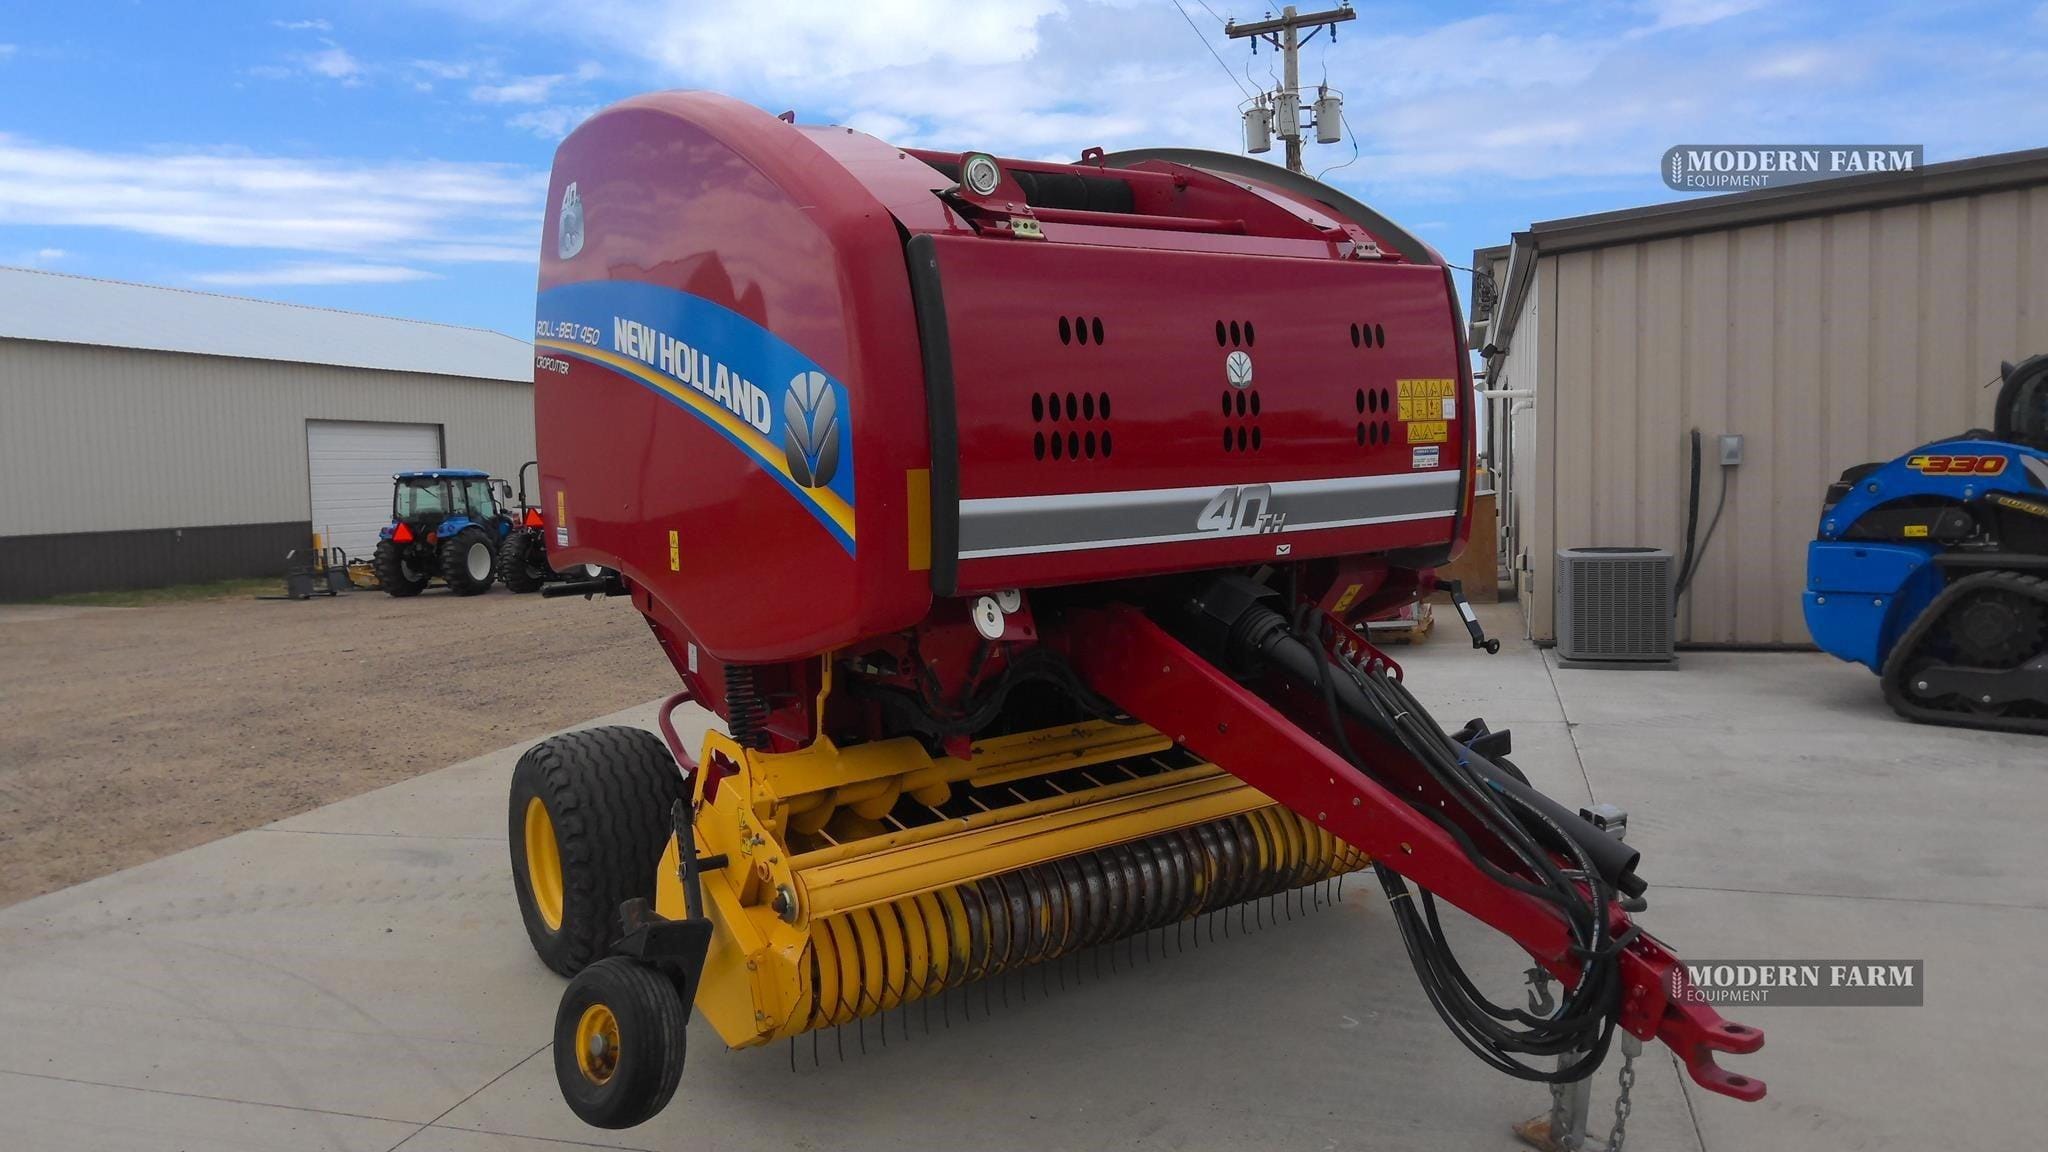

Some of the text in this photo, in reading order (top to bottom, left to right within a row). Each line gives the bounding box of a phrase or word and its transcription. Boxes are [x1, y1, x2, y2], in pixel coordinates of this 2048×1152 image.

[536, 320, 600, 345] ROLL-BELT 450
[614, 316, 772, 434] NEW HOLLAND
[1907, 456, 2006, 474] C330
